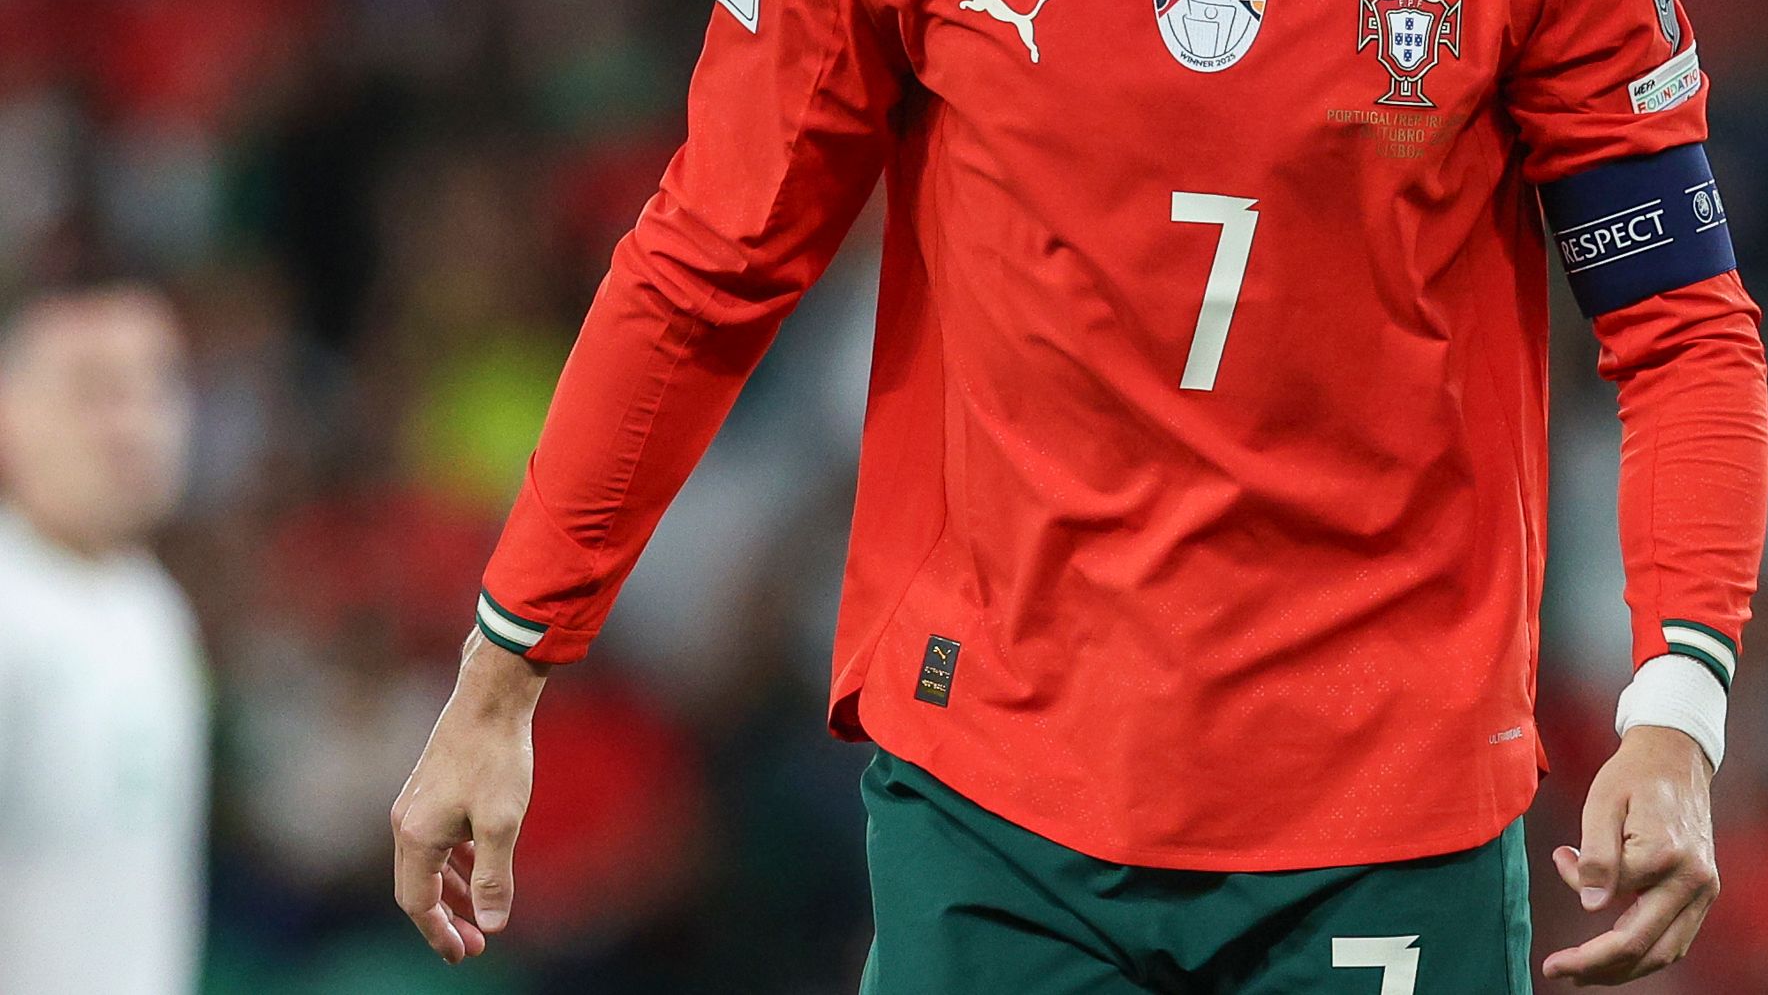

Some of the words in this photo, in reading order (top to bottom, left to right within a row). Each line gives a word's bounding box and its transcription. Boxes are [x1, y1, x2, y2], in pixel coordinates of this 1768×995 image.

[1180, 51, 1214, 68] WINNER
[1216, 52, 1236, 67] 2025
[1633, 78, 1656, 97] UEFA
[1637, 68, 1699, 113] FOUNDATIO
[1560, 209, 1664, 265] RESPECT
[1171, 191, 1260, 392] 7
